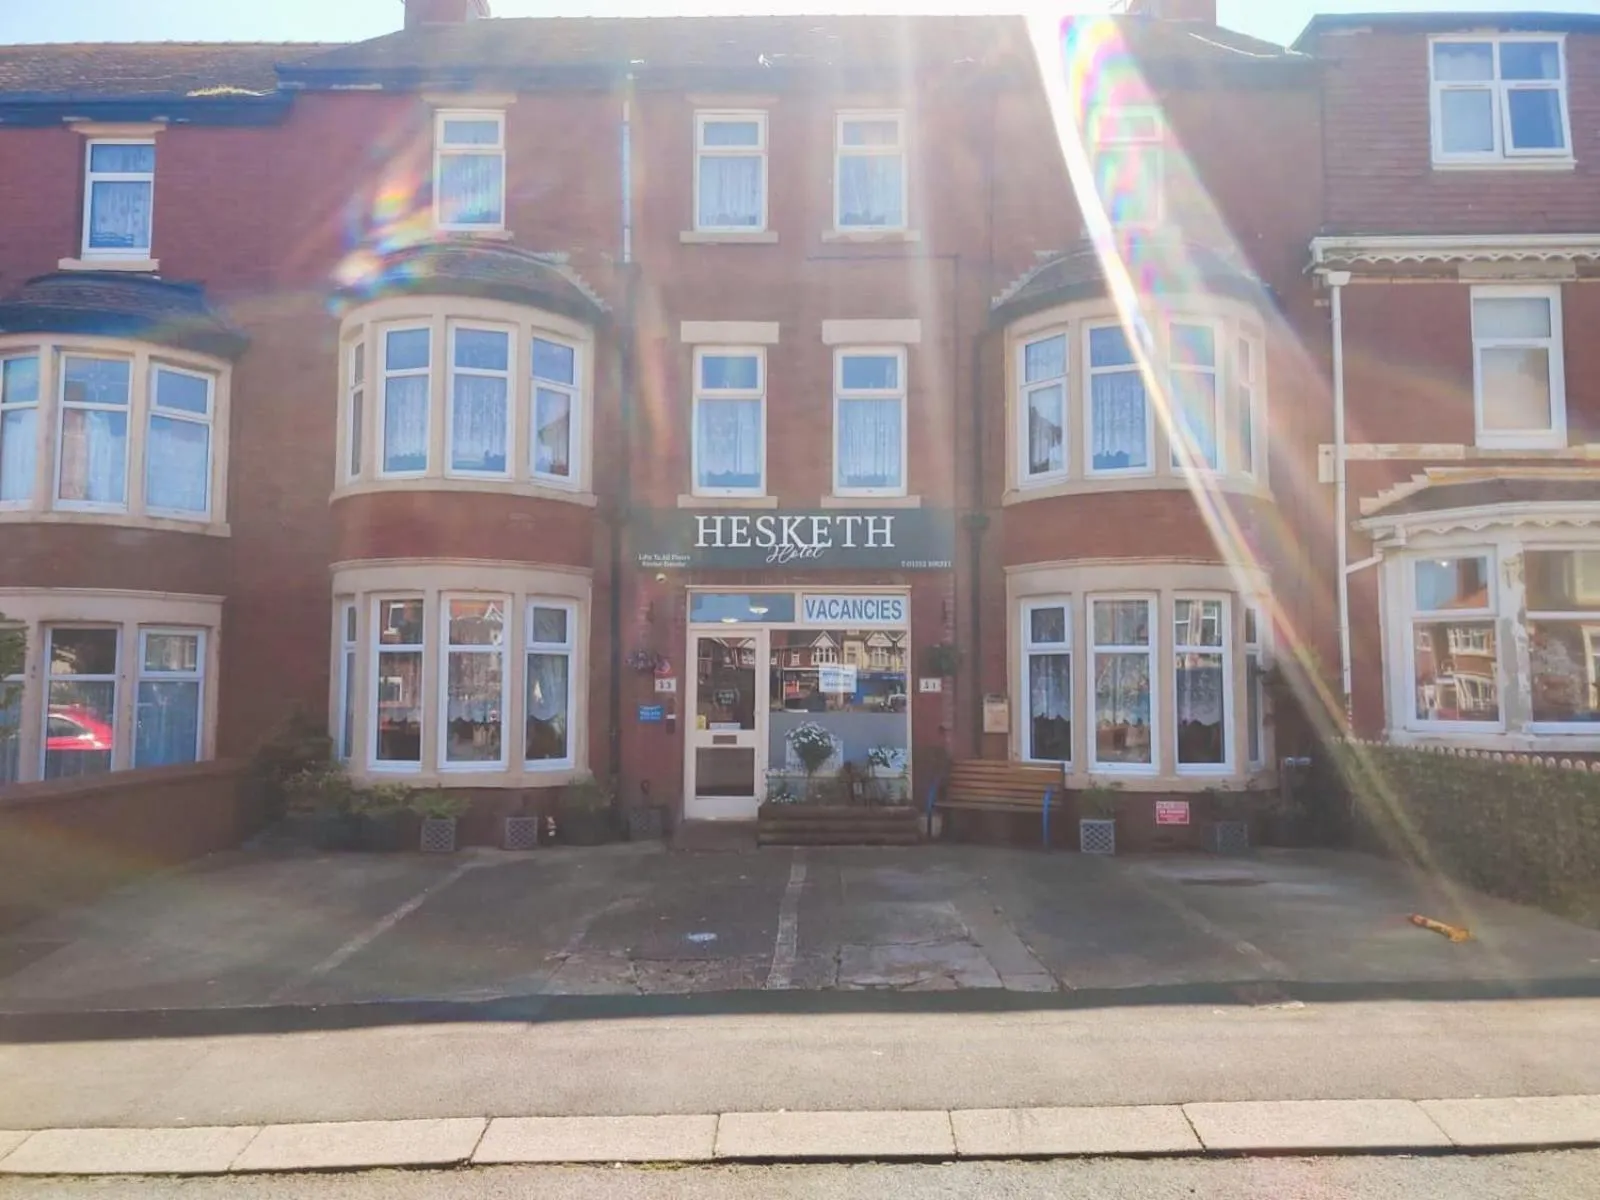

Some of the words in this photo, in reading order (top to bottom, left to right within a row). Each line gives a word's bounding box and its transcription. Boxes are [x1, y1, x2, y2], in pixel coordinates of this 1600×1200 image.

[694, 515, 896, 548] HESKETH
[766, 543, 825, 564] Hotel
[805, 599, 903, 620] VACANCIES
